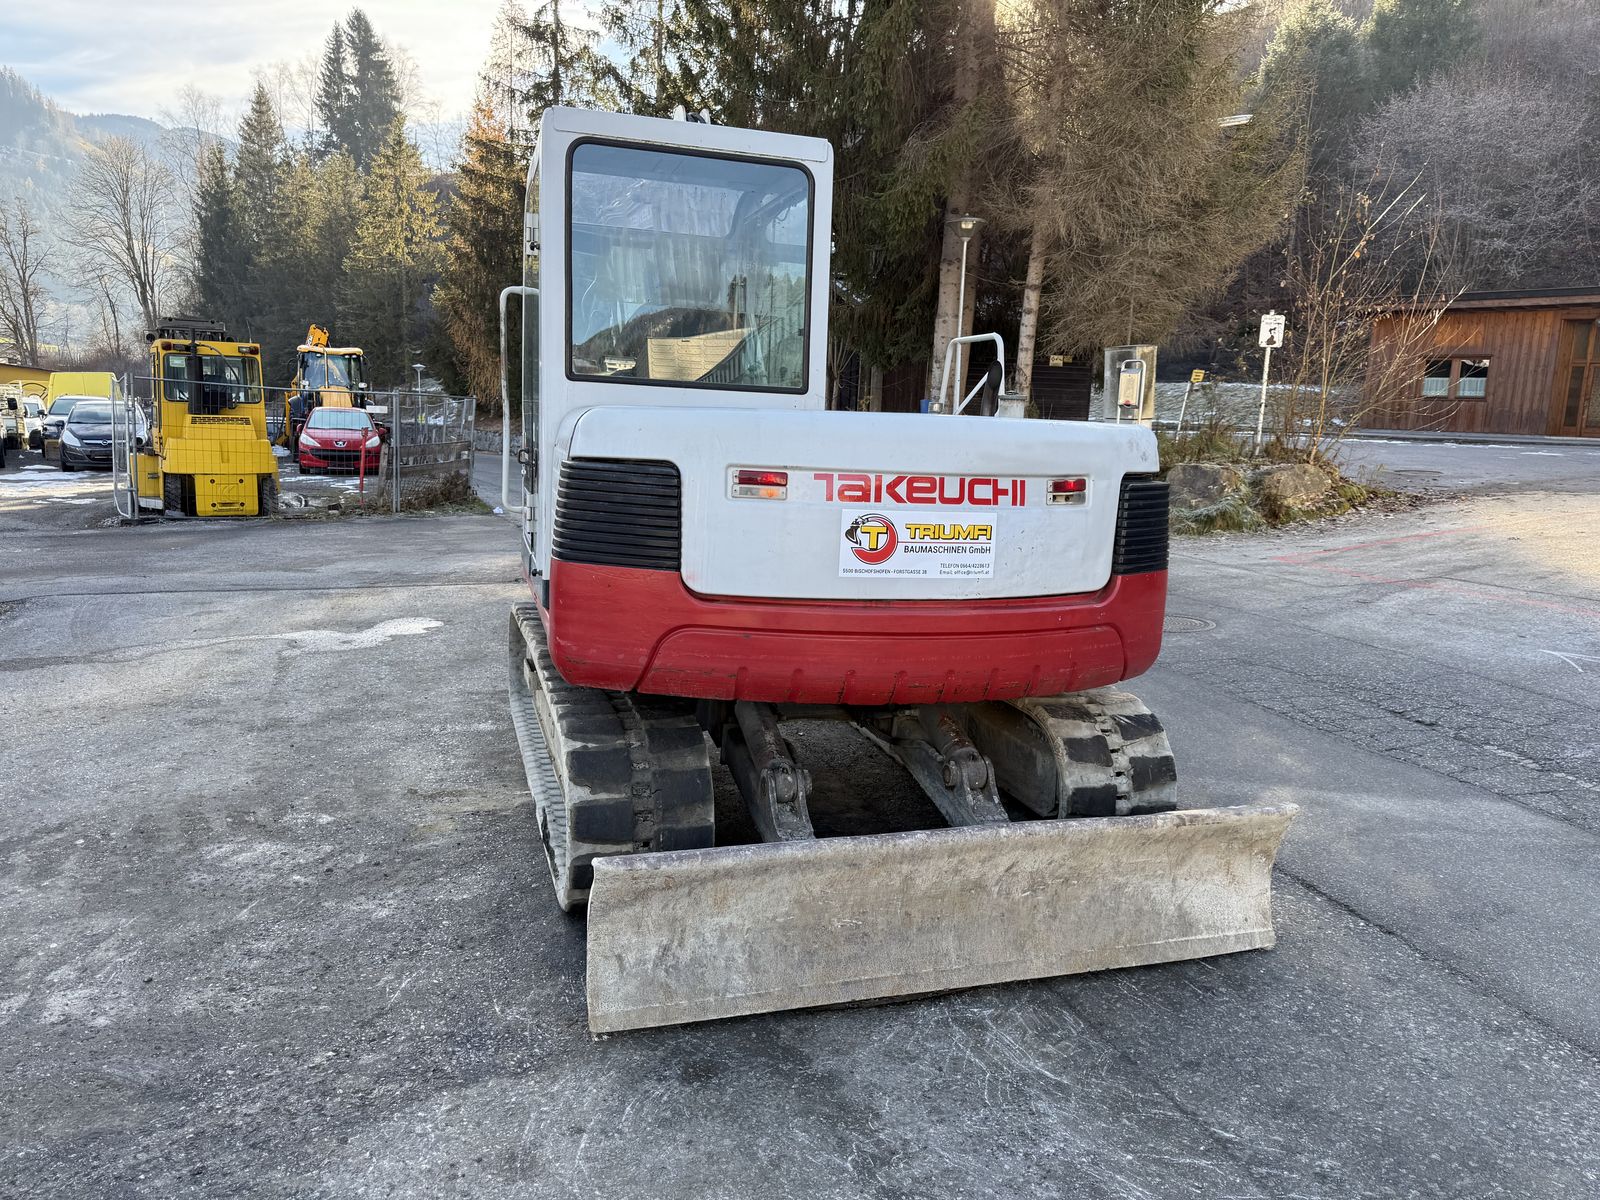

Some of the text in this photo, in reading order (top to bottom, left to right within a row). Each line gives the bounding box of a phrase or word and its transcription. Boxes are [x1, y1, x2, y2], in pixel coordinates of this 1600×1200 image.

[861, 525, 888, 550] T
[905, 523, 992, 540] TRIUMFI
[904, 545, 991, 554] BAUMASCHINEN GmbH
